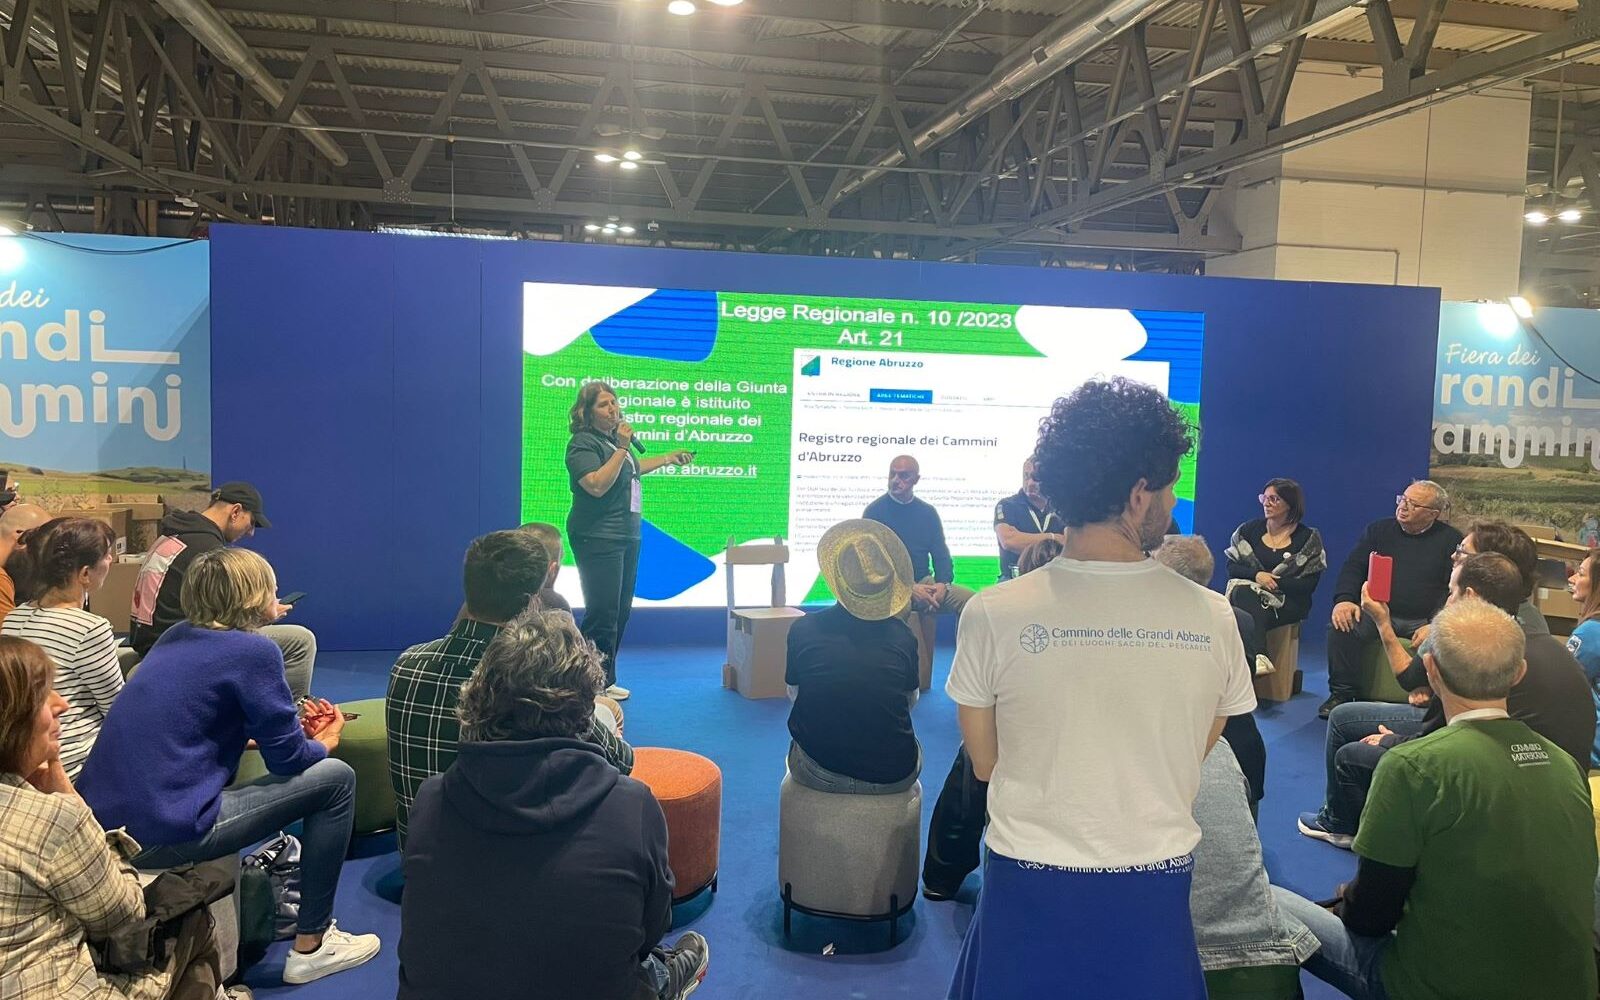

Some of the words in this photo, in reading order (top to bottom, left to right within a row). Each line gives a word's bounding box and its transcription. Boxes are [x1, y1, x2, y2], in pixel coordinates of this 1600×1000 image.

[0, 280, 50, 308] dei
[721, 300, 787, 322] Legge
[793, 304, 896, 325] Regionale
[901, 312, 919, 325] n.
[928, 310, 951, 326] 10
[955, 311, 1012, 329] /2023
[0, 309, 180, 364] ndi
[837, 328, 873, 346] Art.
[879, 330, 903, 346] 21
[831, 356, 876, 368] Regione
[879, 358, 924, 369] Abruzzo
[1445, 343, 1504, 365] Fiera
[1507, 343, 1541, 366] dei
[541, 374, 576, 388] Con
[694, 380, 731, 392] della
[736, 380, 788, 394] Giunta
[1440, 366, 1600, 409] randi
[0, 371, 182, 441] mini
[618, 395, 677, 409] gionale
[681, 396, 691, 408] è
[696, 396, 751, 410] istituito
[621, 411, 659, 424] istro
[660, 412, 734, 427] regionale
[738, 414, 762, 427] dei
[631, 429, 670, 441] mini
[674, 430, 753, 443] d'Abruzzo
[799, 432, 853, 446] Registro
[857, 434, 917, 447] regionale
[919, 435, 939, 445] dei
[942, 436, 998, 447] Cammini
[1432, 416, 1600, 470] ammin
[798, 451, 862, 463] d'Abruzzo
[649, 464, 758, 477] ne.abruzzo.it
[1051, 627, 1104, 638] Cammino
[1107, 627, 1133, 639] delle
[1136, 628, 1174, 640] Grandi
[1176, 630, 1211, 643] Abbazie
[1117, 640, 1144, 648] SACRI
